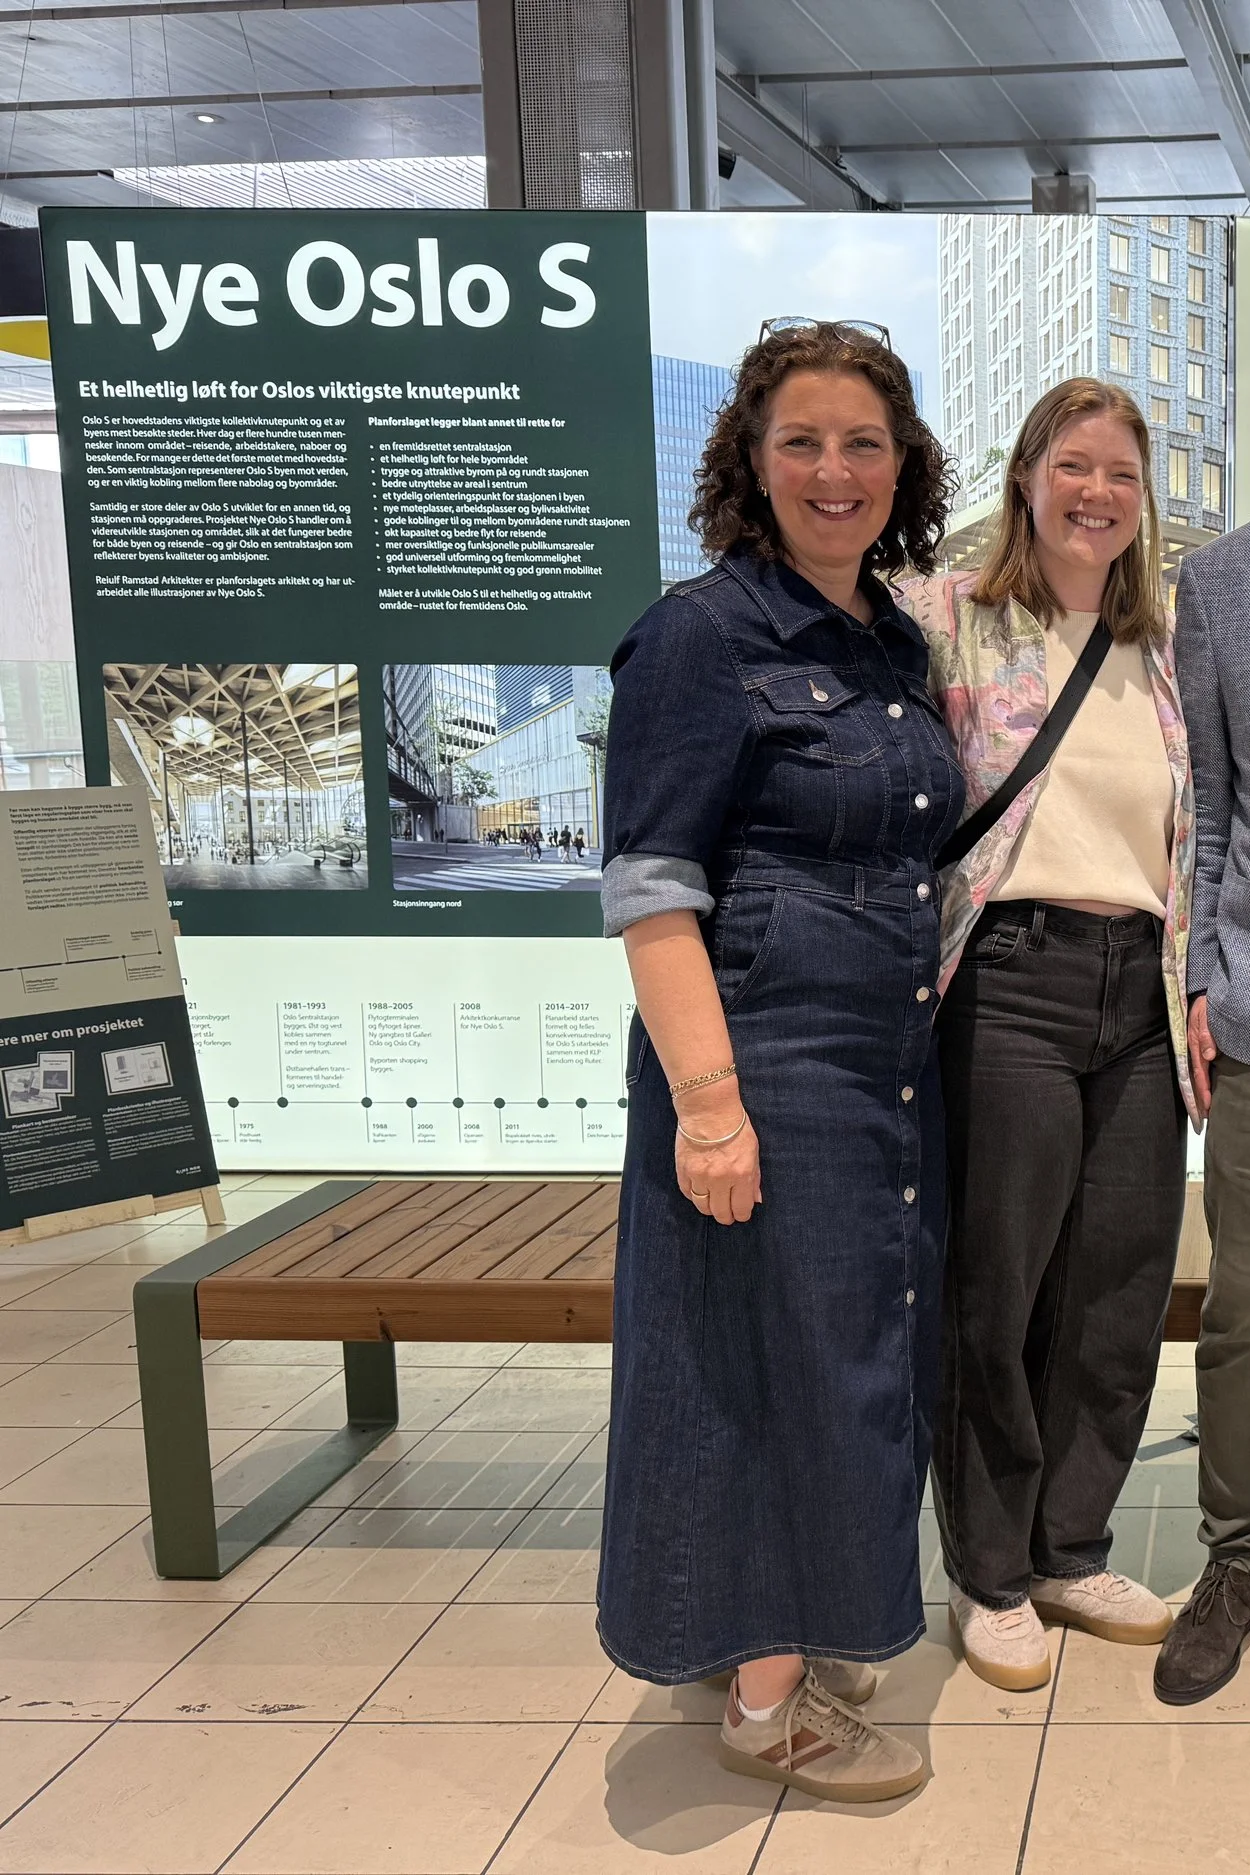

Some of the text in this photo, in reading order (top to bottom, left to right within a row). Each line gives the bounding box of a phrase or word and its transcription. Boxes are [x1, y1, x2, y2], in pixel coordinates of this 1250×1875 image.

[65, 237, 596, 352] Nye Oslo S
[79, 380, 521, 404] Et helhetlig løft for Oslos viktigste knutepunkt
[82, 415, 345, 428] Oslo S er hovedstadens viktigste kollektivknutepunkt og et av
[368, 416, 566, 429] Planforslaget legger blant annet til rette for
[379, 441, 512, 454] en fremtidsrettet sentralstasjon
[392, 899, 446, 909] Stasjonsinngang
[460, 1002, 481, 1010] 2008
[21, 1032, 49, 1044] mer
[51, 1028, 74, 1039] om
[76, 1017, 144, 1038] prosjektet
